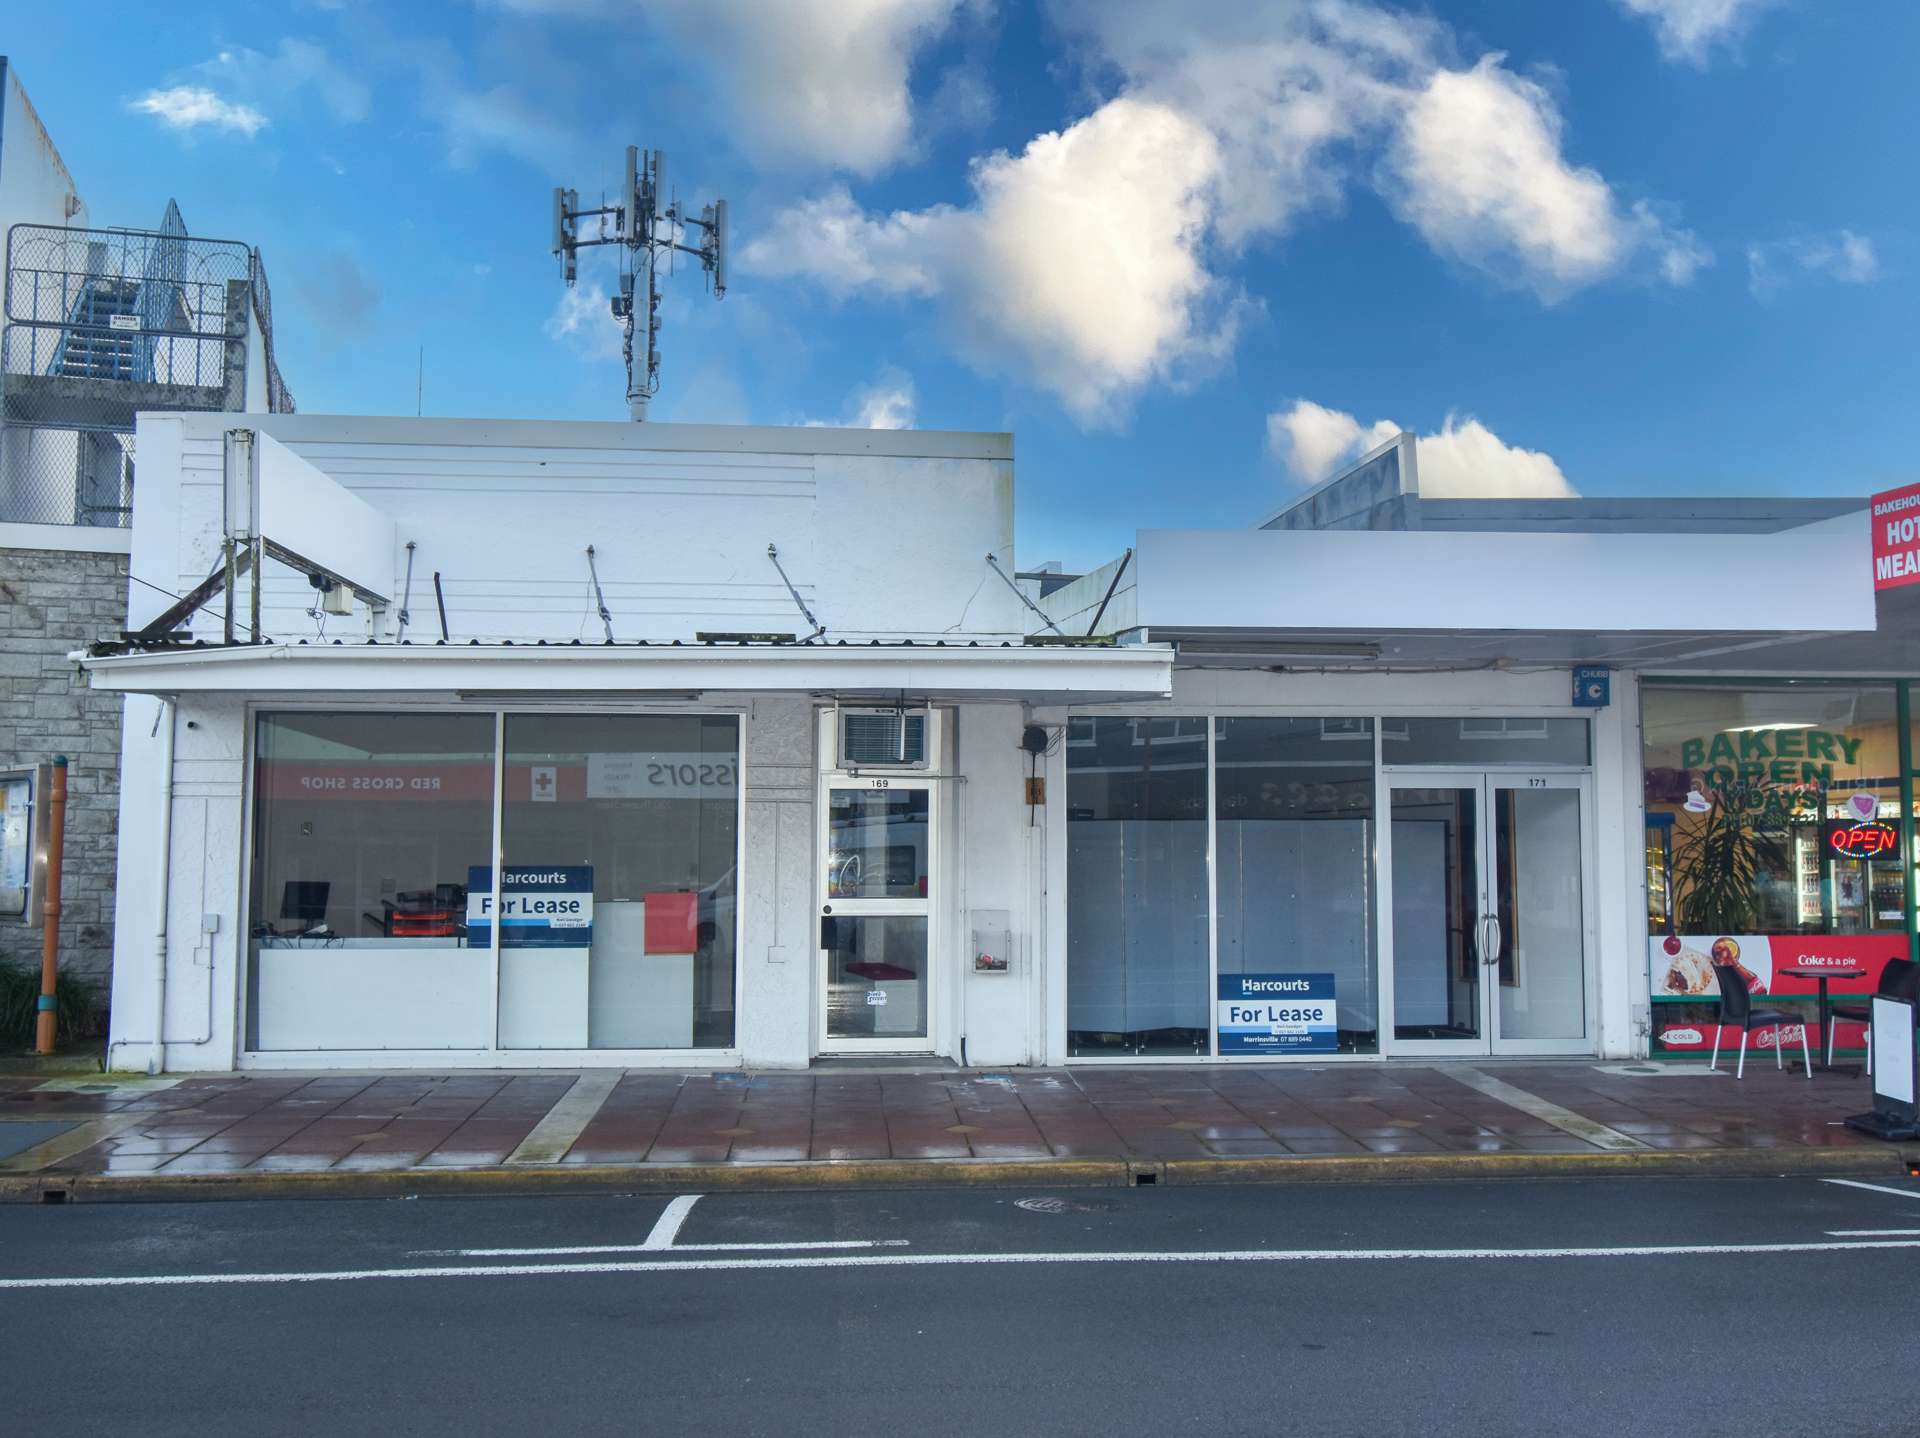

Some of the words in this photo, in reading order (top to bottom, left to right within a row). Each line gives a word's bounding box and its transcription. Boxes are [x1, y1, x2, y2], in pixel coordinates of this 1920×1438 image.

[1681, 729, 1863, 769] BAKERY
[1529, 778, 1547, 787] 171
[1705, 761, 1834, 787] OPEN
[871, 779, 889, 788] 169
[1831, 829, 1896, 850] OPEN
[522, 897, 580, 914] Lease
[1798, 955, 1825, 966] Coke
[1827, 958, 1833, 966] &
[1842, 957, 1857, 968] pie
[1242, 979, 1310, 991] Harcourts
[1230, 1006, 1262, 1023] For
[1268, 1006, 1323, 1022] Lease
